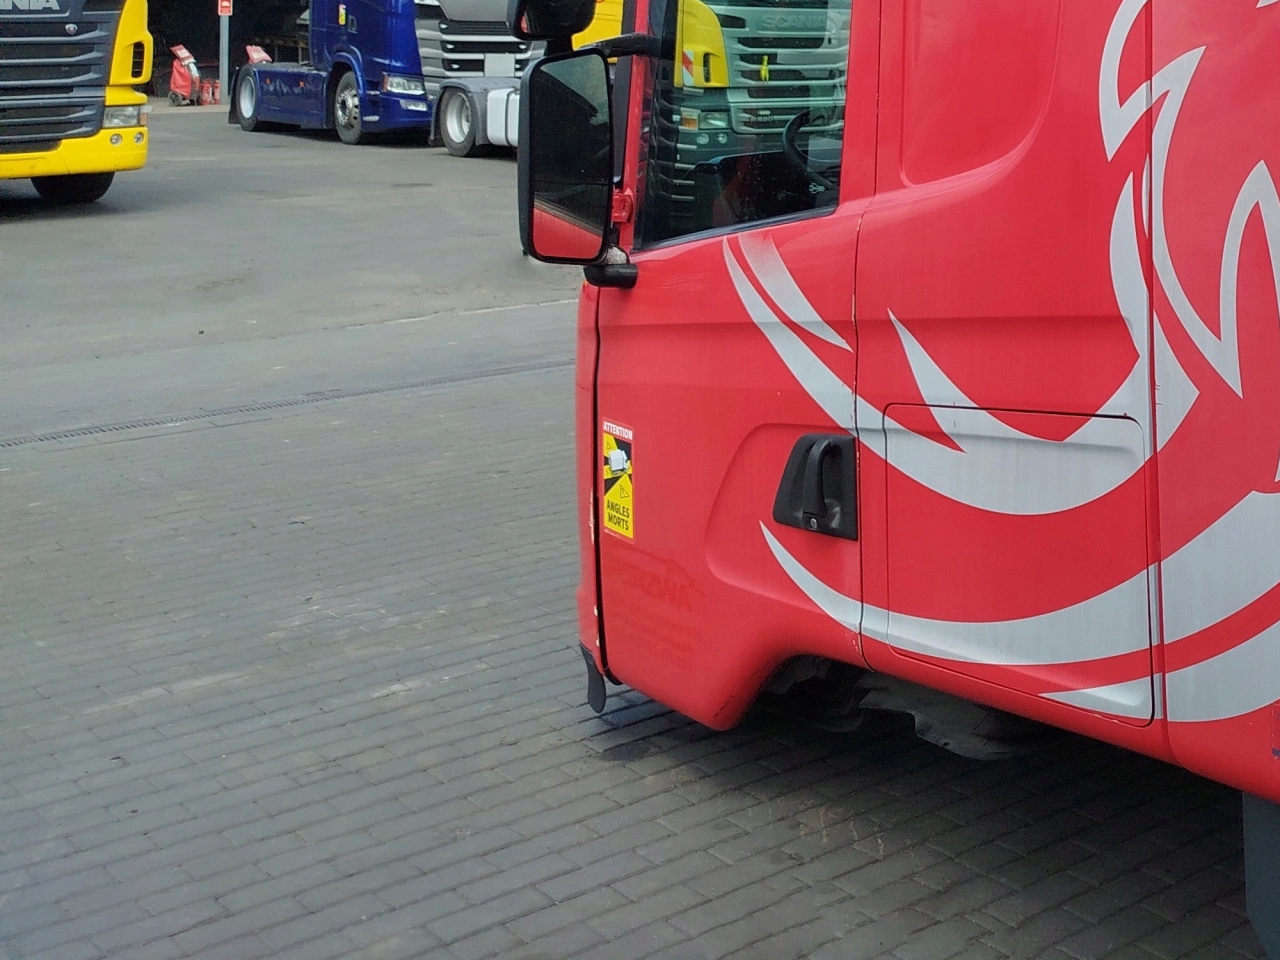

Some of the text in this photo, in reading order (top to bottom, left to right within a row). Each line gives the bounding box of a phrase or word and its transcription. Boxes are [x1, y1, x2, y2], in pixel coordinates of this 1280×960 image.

[762, 14, 828, 29] SCANIA
[603, 420, 633, 441] ATTENTION
[606, 499, 630, 519] ANGLES
[607, 512, 629, 531] MORTS
